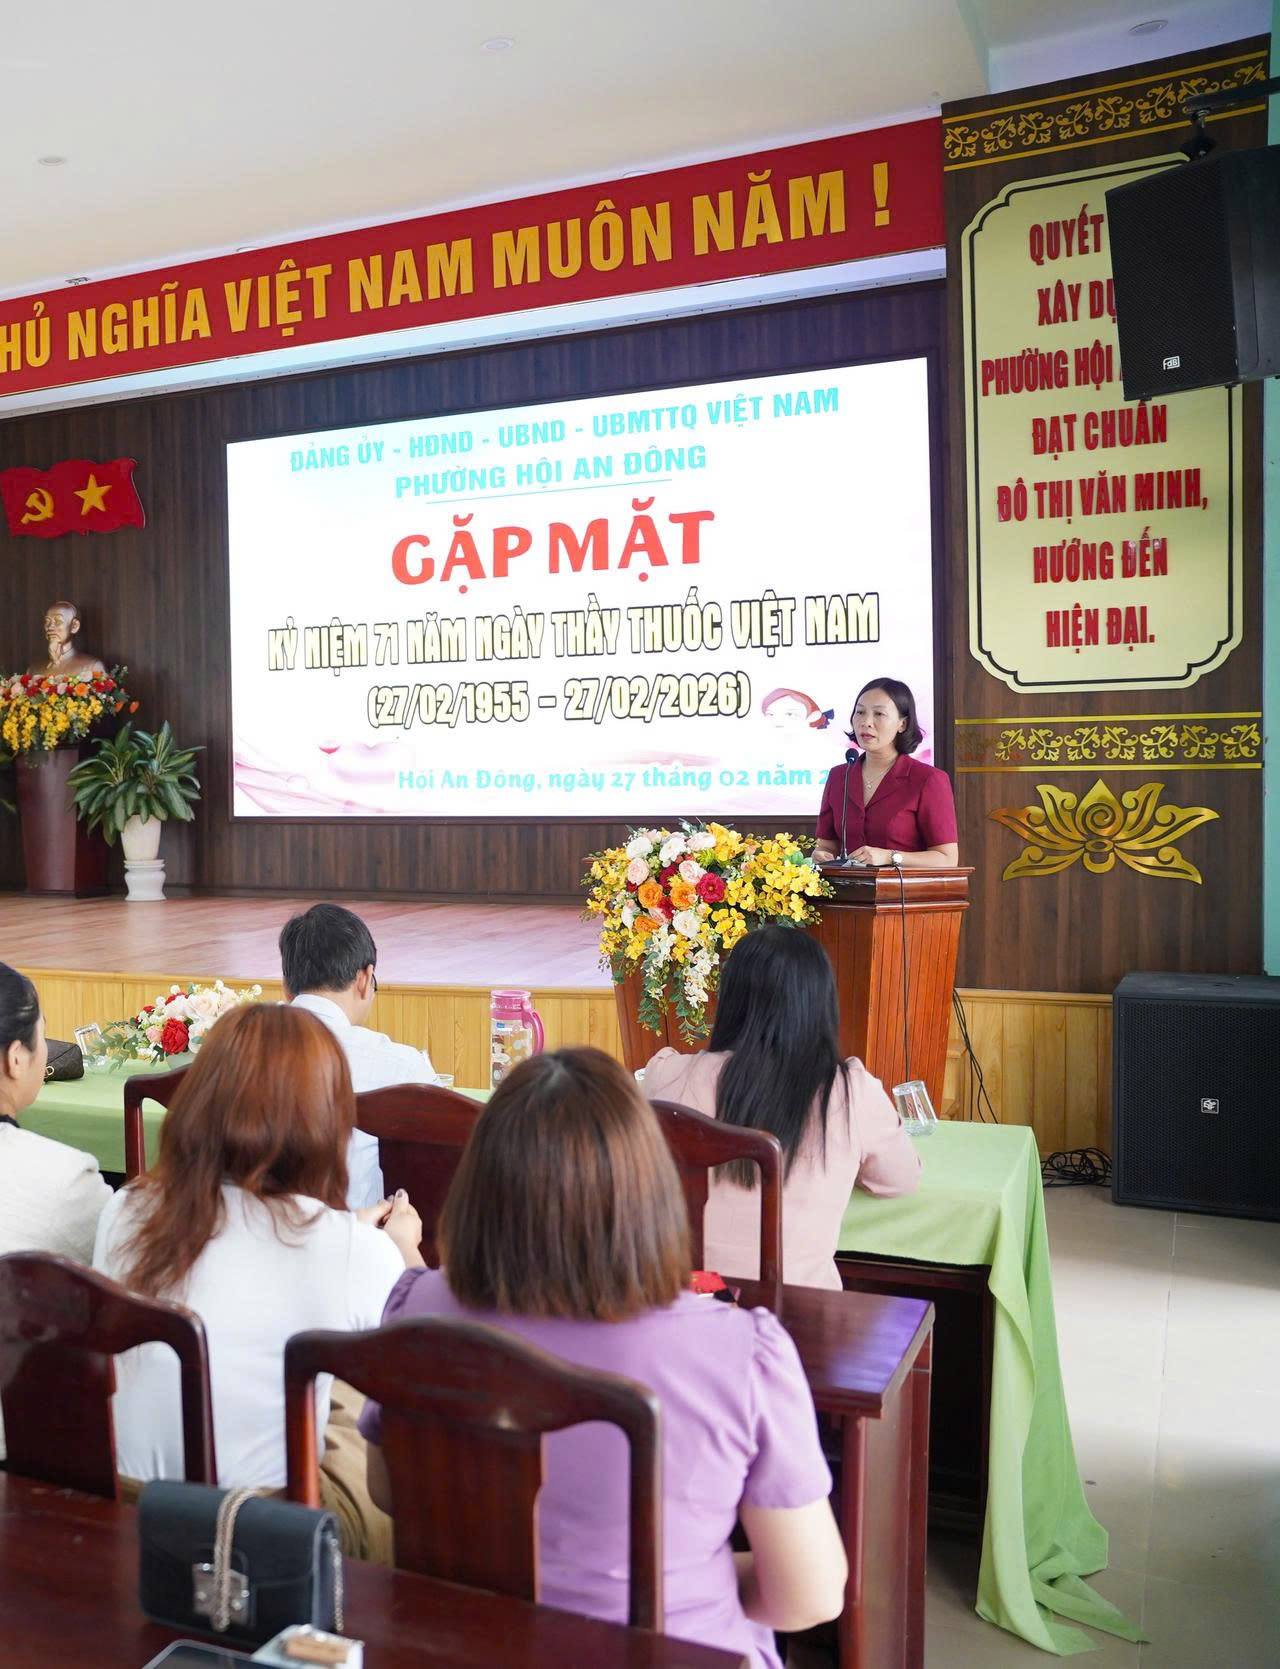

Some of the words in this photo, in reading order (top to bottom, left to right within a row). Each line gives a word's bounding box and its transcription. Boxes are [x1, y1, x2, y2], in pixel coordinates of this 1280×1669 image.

[68, 281, 212, 360] NGHĨA
[224, 259, 332, 337] VIỆT
[348, 238, 473, 312] NAM
[492, 200, 673, 289] MUÔN
[693, 169, 846, 255] NĂM
[872, 162, 891, 227] !
[1029, 203, 1104, 266] QUYẾT
[1037, 279, 1081, 326] XÂY
[981, 348, 1068, 396] PHƯỜNG
[1074, 339, 1113, 391] HỘI
[409, 430, 473, 458] HĐND
[498, 419, 566, 449] UBND
[592, 403, 697, 438] UBMTTQ
[706, 393, 763, 428] VIỆT
[773, 387, 840, 418] NAM
[1032, 413, 1077, 461] ĐẠT
[395, 464, 506, 498] PHƯỜNG
[573, 455, 613, 480] AN
[623, 444, 707, 475] ĐÔNG
[997, 477, 1027, 522] ĐÔ
[1034, 479, 1073, 524] THỊ
[1080, 470, 1126, 516] VĂN
[1135, 468, 1208, 512] MINH,
[391, 512, 532, 594] GẶP
[548, 497, 715, 582] MẶT
[1033, 537, 1114, 584] HƯỚNG
[1121, 526, 1168, 578] ĐẾN
[304, 617, 368, 677] NIỆM
[374, 622, 399, 665] 71
[407, 611, 467, 664] NĂM
[475, 605, 545, 661] NGÀY
[551, 592, 620, 657] THẦY
[627, 586, 723, 653] THUỐC
[730, 589, 796, 657] VIỆT
[805, 592, 880, 645] NAM
[1046, 602, 1099, 653] HIỆN
[1107, 606, 1155, 651] ĐẠI.
[367, 681, 530, 729] (27/02/1955
[564, 671, 752, 725] 27/02/2026)
[441, 769, 469, 789] An
[548, 768, 605, 793] ngày
[610, 771, 636, 791] 27
[643, 765, 712, 791] tháng
[719, 769, 750, 786] 02
[757, 764, 812, 786] năm
